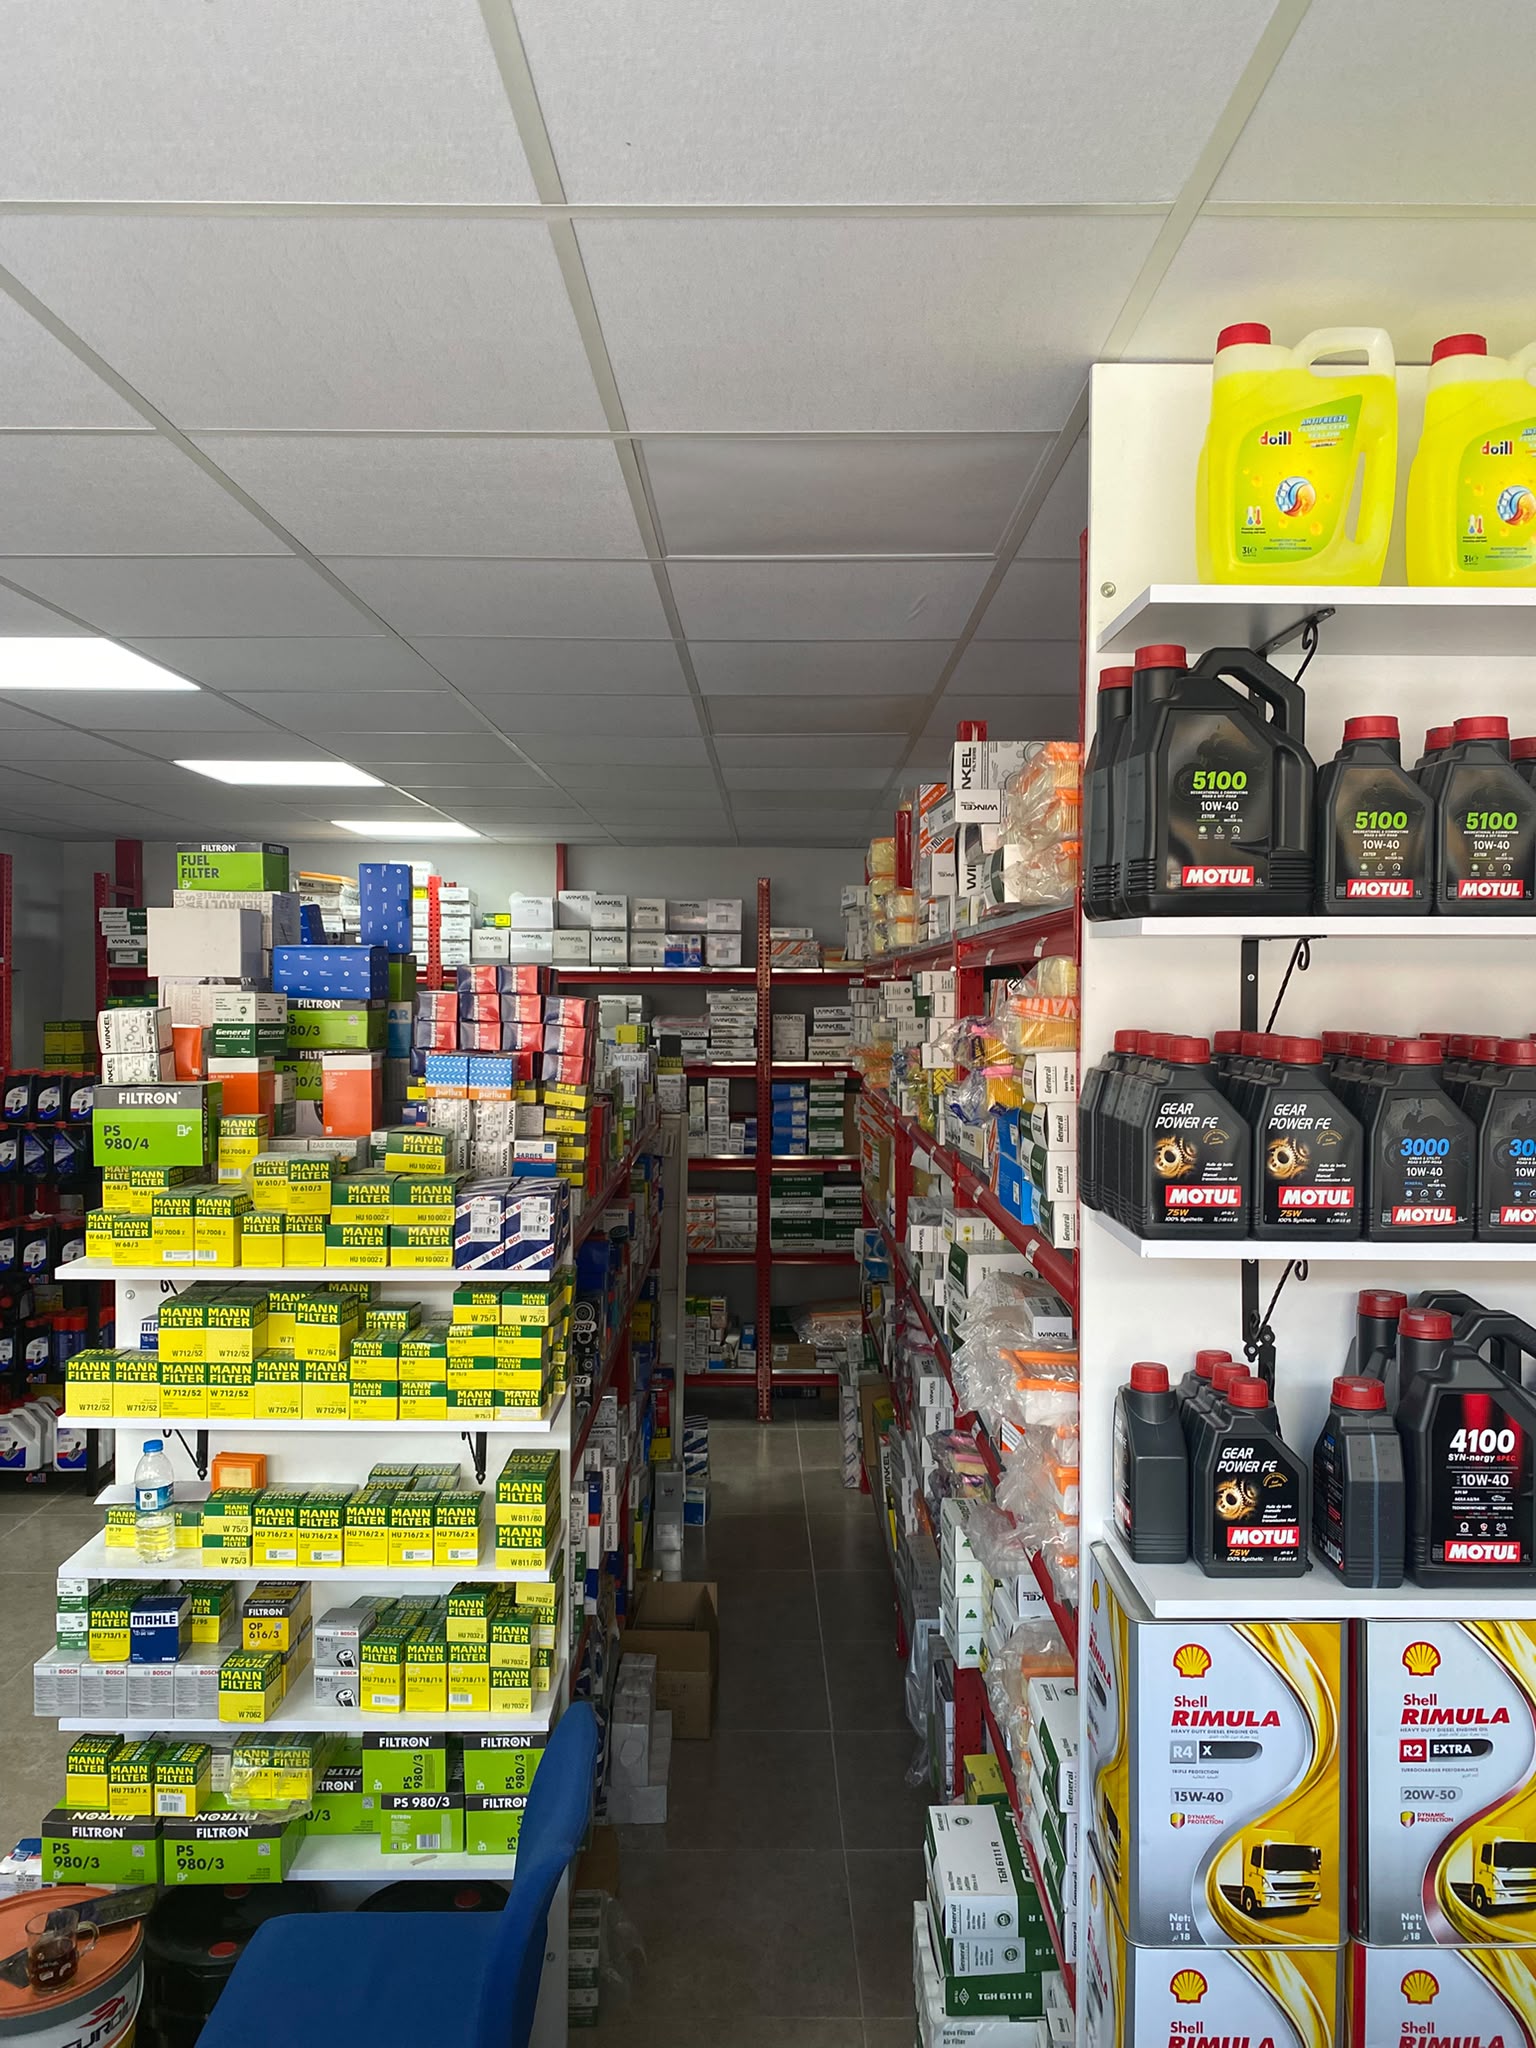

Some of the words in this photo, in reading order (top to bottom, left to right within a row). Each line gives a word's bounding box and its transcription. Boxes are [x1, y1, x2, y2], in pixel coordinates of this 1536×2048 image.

[1259, 431, 1292, 446] doill
[1481, 440, 1514, 455] doill
[1192, 770, 1247, 791] 5100
[960, 803, 999, 811] WINKEL
[1200, 800, 1239, 812] 10W-40
[1355, 811, 1408, 830] 5100
[1465, 811, 1518, 830] 5100
[201, 844, 236, 852] FILTRON
[1362, 840, 1400, 850] 10W-40
[1473, 840, 1511, 850] 10W-40
[181, 855, 210, 866] FUEL
[181, 868, 220, 879] FILTER
[1185, 868, 1251, 884] MOTUL
[1255, 877, 1264, 885] 4L
[1350, 882, 1410, 896] MOTUL
[1461, 882, 1521, 896] MOTUL
[297, 1000, 341, 1009] FILTRON
[103, 1014, 112, 1050] WINKEL
[215, 1028, 251, 1036] General
[1044, 1066, 1052, 1094] General
[118, 1091, 178, 1105] FILTRON
[435, 1088, 463, 1099] purflux
[478, 1089, 507, 1100] purflux
[1160, 1102, 1194, 1115] GEAR
[1273, 1103, 1308, 1116] GEAR
[220, 1119, 256, 1128] MANN
[505, 1106, 514, 1135] WINKEL
[1154, 1116, 1200, 1129] POWER
[1202, 1116, 1219, 1129] FE
[1268, 1117, 1314, 1130] POWER
[1315, 1117, 1332, 1130] FE
[103, 1124, 121, 1137] PS
[220, 1127, 256, 1137] FILTER
[1056, 1115, 1064, 1143] General
[103, 1137, 150, 1150] 980/4
[402, 1134, 443, 1145] MANN
[402, 1143, 443, 1154] FILTER
[1400, 1137, 1450, 1157] 3000
[426, 1163, 437, 1171] 002
[1405, 1167, 1443, 1177] 10W-40
[1056, 1166, 1064, 1194] General
[291, 1184, 299, 1192] W
[299, 1184, 322, 1192] 610/3
[1169, 1188, 1238, 1205] MOTUL
[1282, 1189, 1351, 1206] MOTUL
[1166, 1208, 1190, 1217] 75W
[1395, 1208, 1453, 1222] MOTUL
[1180, 1216, 1204, 1224] Synthetic
[160, 1307, 203, 1317] MANN
[471, 1314, 479, 1322] W
[479, 1313, 497, 1323] 75/3
[160, 1317, 203, 1327] FILTER
[171, 1349, 180, 1357] W
[179, 1349, 203, 1358] 712/52
[1449, 1428, 1516, 1454] 4100
[1221, 1447, 1254, 1460] GEAR
[1216, 1460, 1260, 1473] POWER
[1261, 1460, 1278, 1473] FE
[1461, 1474, 1509, 1487] 10W-40
[254, 1507, 295, 1517] MANN
[254, 1517, 295, 1526] FILTER
[510, 1514, 519, 1522] W
[518, 1514, 543, 1523] 811/80
[266, 1531, 288, 1539] 716/2
[1231, 1529, 1296, 1545] MOTUL
[1448, 1543, 1517, 1561] MOTUL
[248, 1607, 283, 1617] FILTRON
[132, 1614, 177, 1626] MAHLE
[248, 1622, 263, 1631] OP
[248, 1630, 280, 1639] 616/3
[407, 1676, 418, 1684] HU
[419, 1676, 438, 1684] 718/1
[1173, 1695, 1208, 1708] Shell
[1403, 1693, 1438, 1706] Shell
[238, 1711, 246, 1719] W
[245, 1711, 262, 1719] 7062
[1171, 1710, 1281, 1727] RIMULA
[1400, 1707, 1511, 1725] RIMULA
[379, 1736, 430, 1748] FILTRON
[1173, 1745, 1193, 1759] R4
[1202, 1745, 1212, 1756] X
[1403, 1744, 1423, 1757] R2
[1433, 1744, 1472, 1754] EXTRA
[1066, 1771, 1074, 1806] General
[1403, 1789, 1456, 1800] 20W-50
[392, 1797, 409, 1808] PS
[411, 1796, 451, 1808] 980/3
[1174, 1791, 1224, 1802] 15W-40
[72, 1826, 124, 1838] FILTRON
[52, 1842, 71, 1855] PS
[52, 1856, 101, 1869] 980/3
[1169, 1913, 1191, 1923] Net:
[1169, 1922, 1181, 1932] 18
[1184, 1922, 1191, 1932] L
[977, 1993, 998, 2001] TGH
[999, 1992, 1022, 2001] 6111
[1170, 2021, 1204, 2035] Shell
[1401, 2021, 1435, 2035] Shell
[1167, 2036, 1276, 2048] RIMULA
[1399, 2034, 1506, 2048] RIMULA
